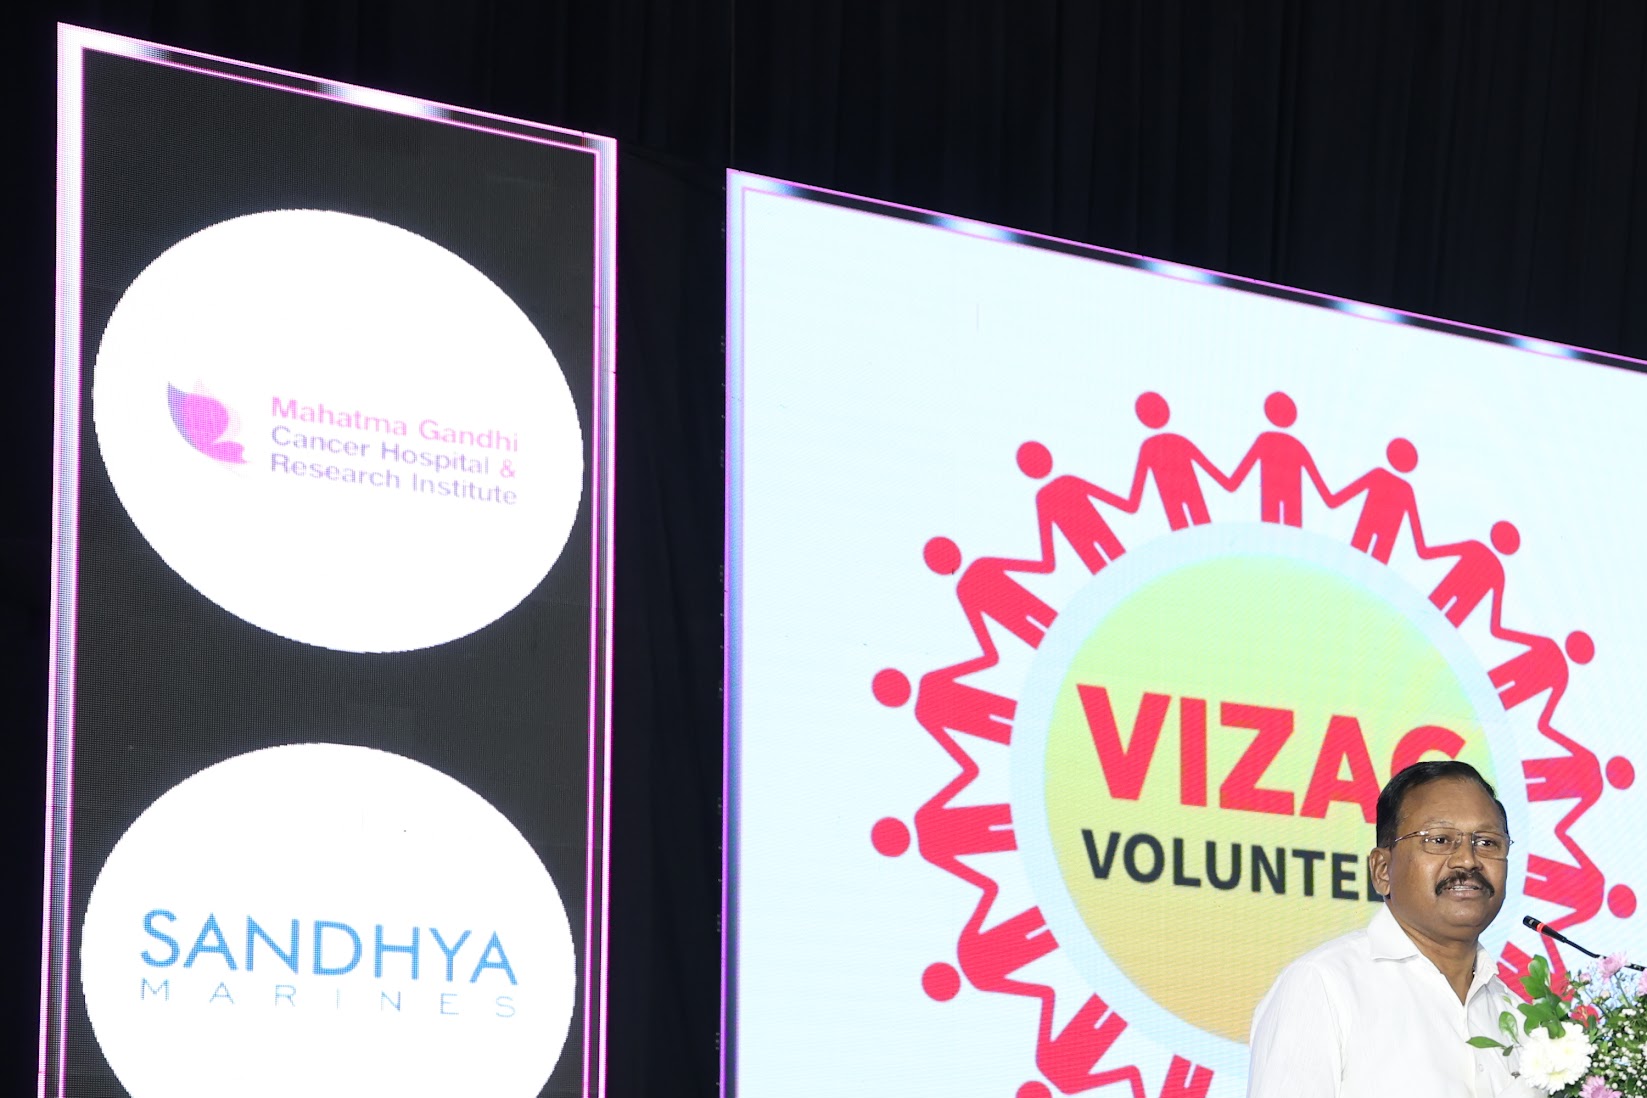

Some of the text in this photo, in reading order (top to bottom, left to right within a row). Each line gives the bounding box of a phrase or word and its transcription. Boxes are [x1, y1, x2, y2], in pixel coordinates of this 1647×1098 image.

[271, 396, 518, 452] Mahatma Gandhi
[271, 424, 516, 478] Cancer Hospital &
[271, 452, 518, 505] Research Institute
[139, 908, 519, 986] SANDHYA
[140, 977, 517, 1018] MARINES
